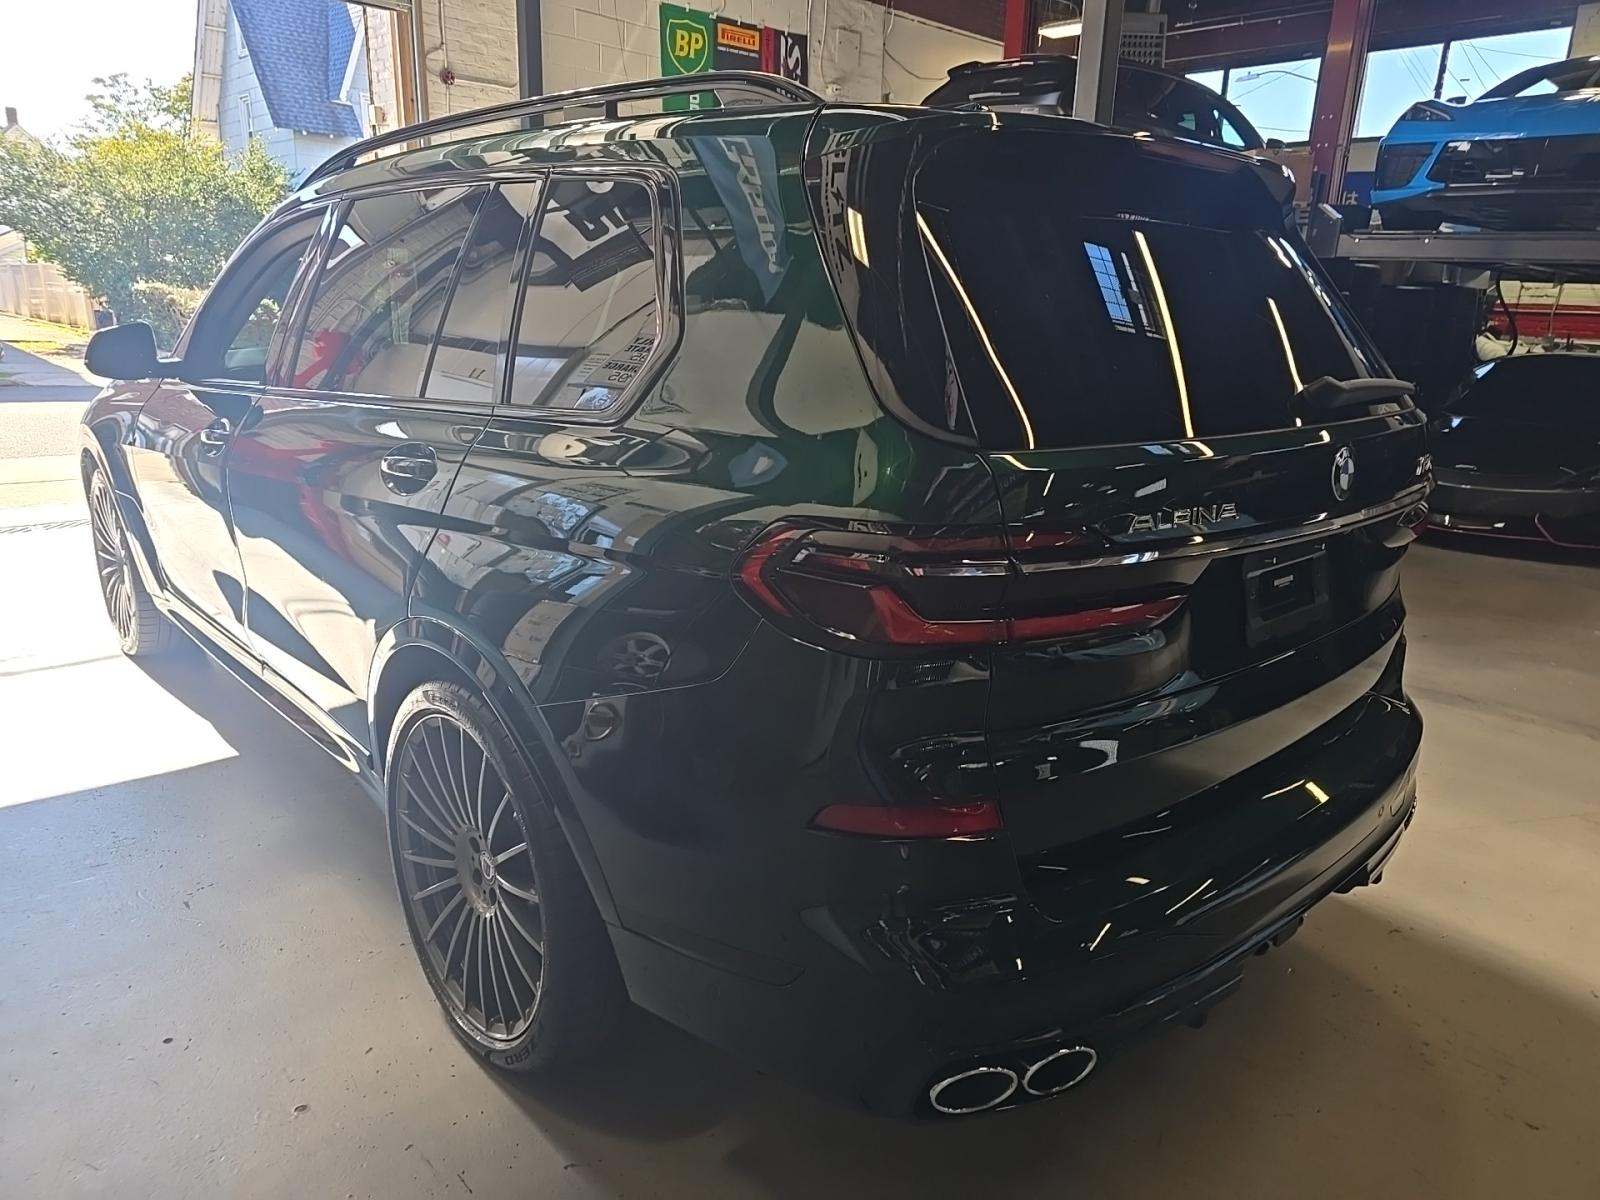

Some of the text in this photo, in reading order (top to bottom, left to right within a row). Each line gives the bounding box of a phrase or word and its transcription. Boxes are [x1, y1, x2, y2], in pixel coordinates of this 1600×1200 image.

[675, 29, 704, 59] BP
[721, 29, 756, 46] PIRELLI
[1128, 503, 1240, 534] ALPINA
